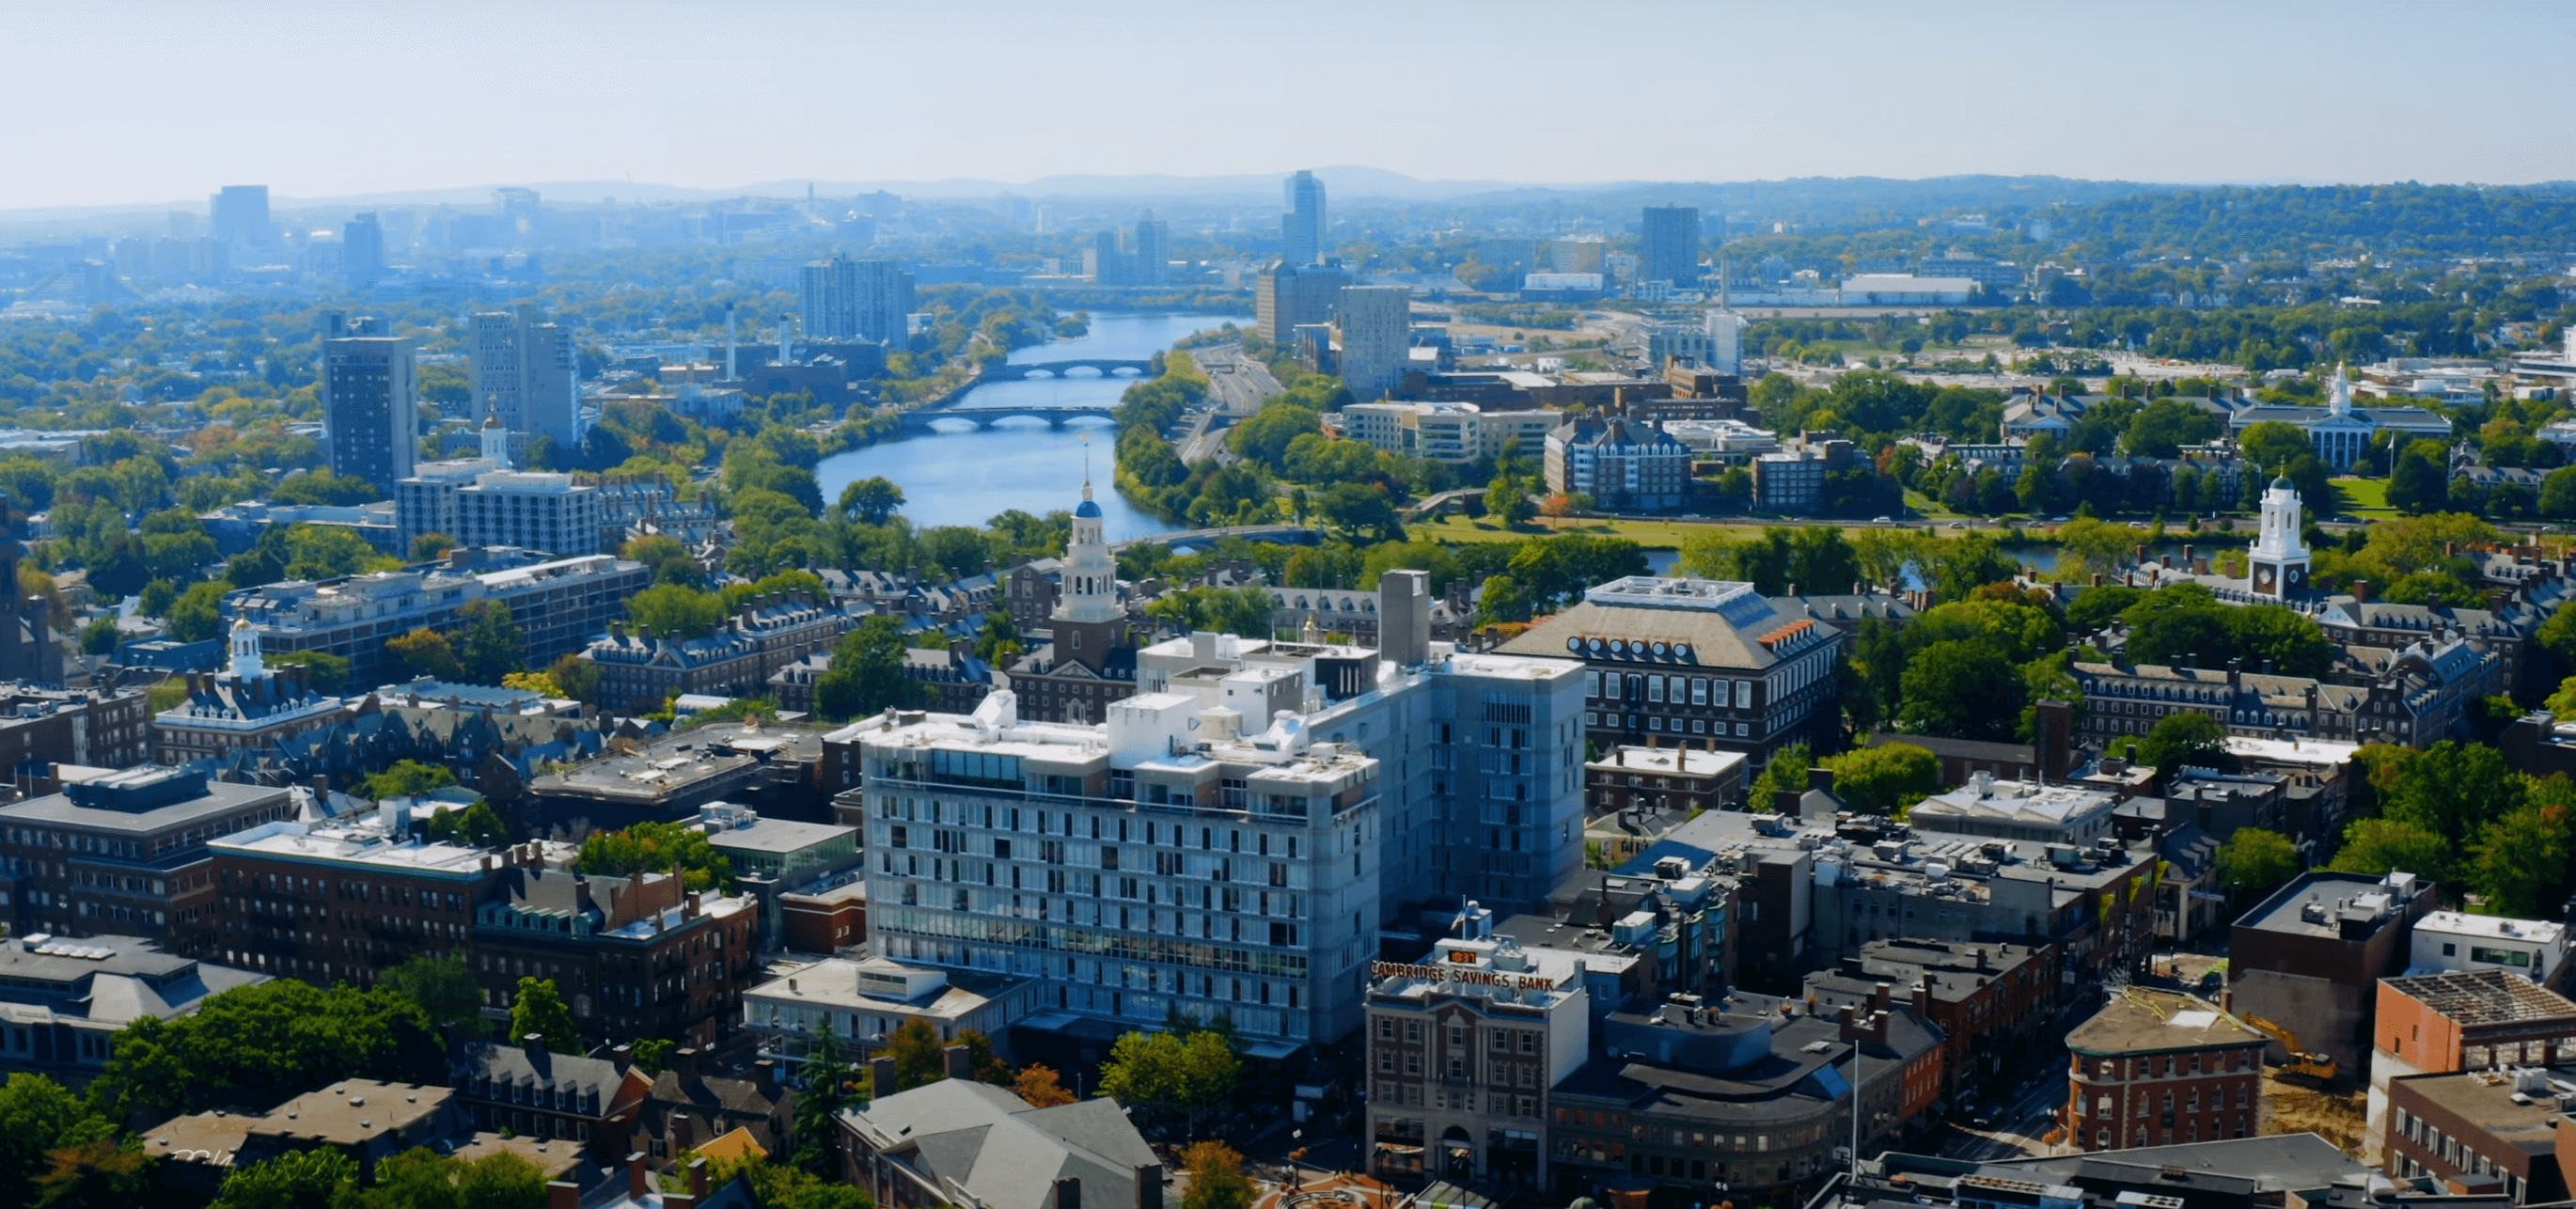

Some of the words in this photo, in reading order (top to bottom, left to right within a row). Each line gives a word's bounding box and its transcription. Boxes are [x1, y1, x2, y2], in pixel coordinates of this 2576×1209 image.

[1370, 960, 1445, 981] CAMBRIDGE
[1453, 970, 1510, 988] SAVINGS
[1518, 976, 1554, 992] BANK
